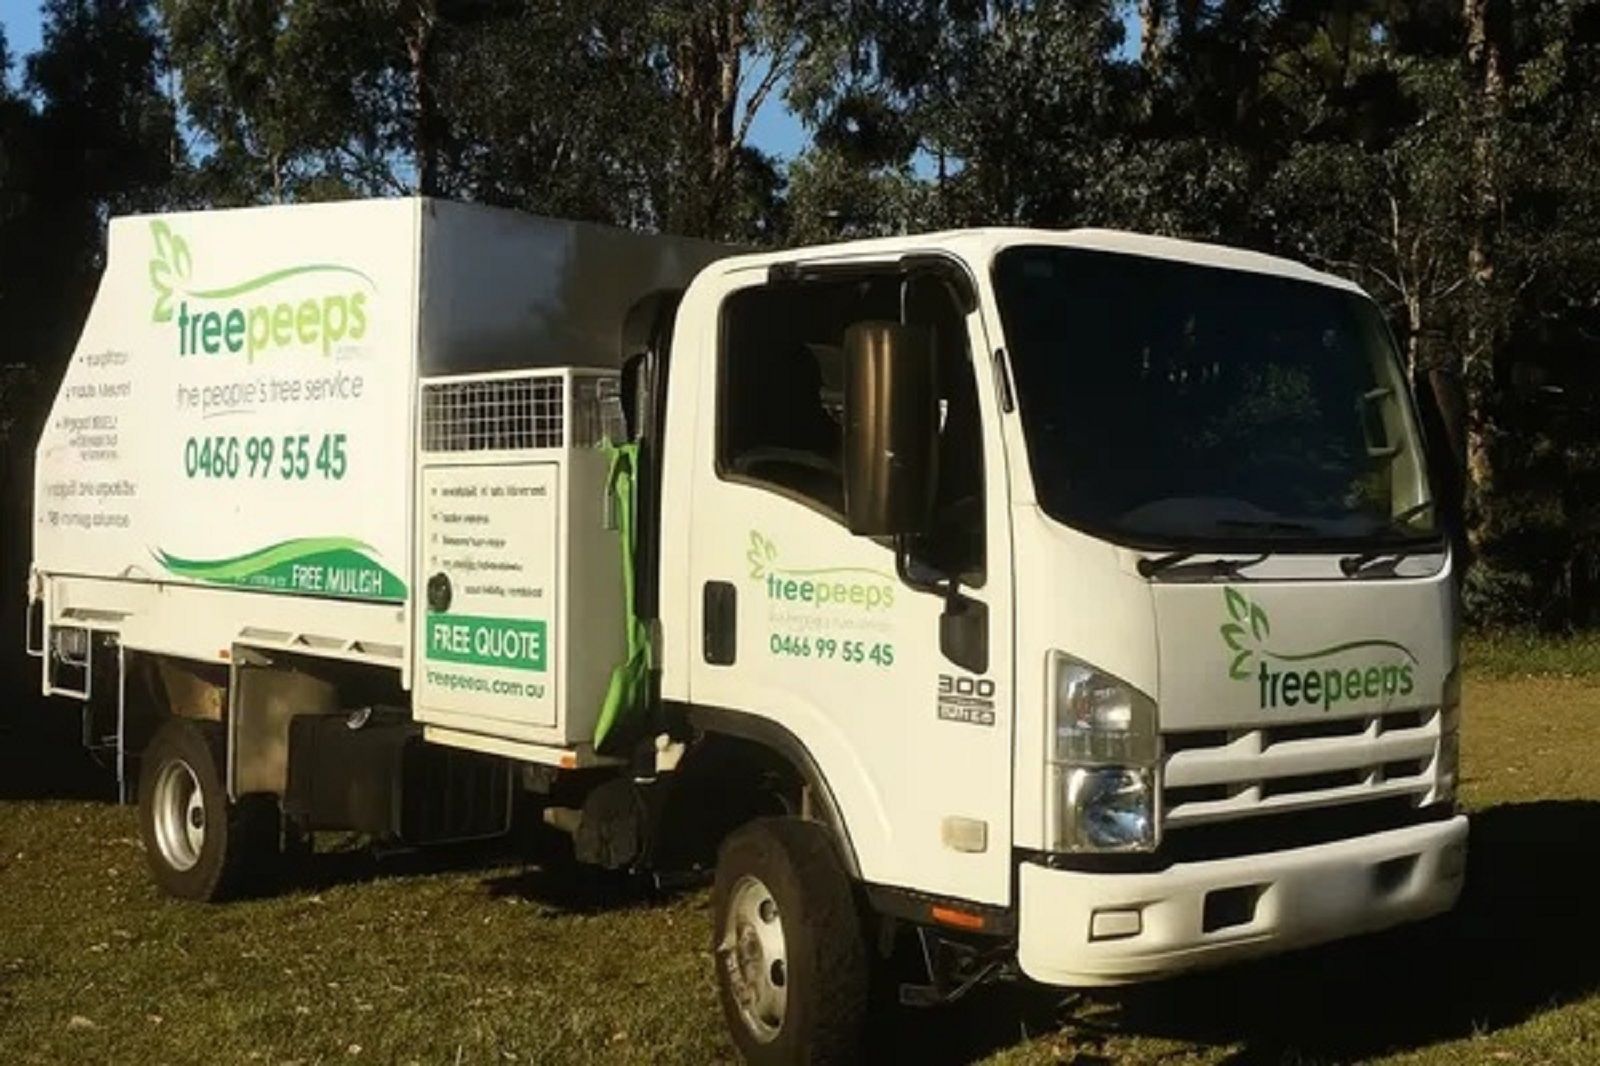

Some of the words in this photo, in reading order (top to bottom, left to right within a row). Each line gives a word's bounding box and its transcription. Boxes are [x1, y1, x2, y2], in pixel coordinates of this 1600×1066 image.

[178, 292, 367, 364] treepeeps
[304, 370, 364, 401] service
[246, 436, 274, 478] 99
[281, 436, 311, 480] 55
[316, 434, 347, 480] 45
[767, 573, 895, 611] treepeeps
[434, 624, 470, 653] FREE
[475, 626, 540, 660] QUOTE
[816, 639, 837, 659] 99
[843, 642, 865, 663] 55
[869, 644, 894, 666] 45
[938, 673, 996, 698] 300
[1259, 661, 1415, 711] treepeeps
